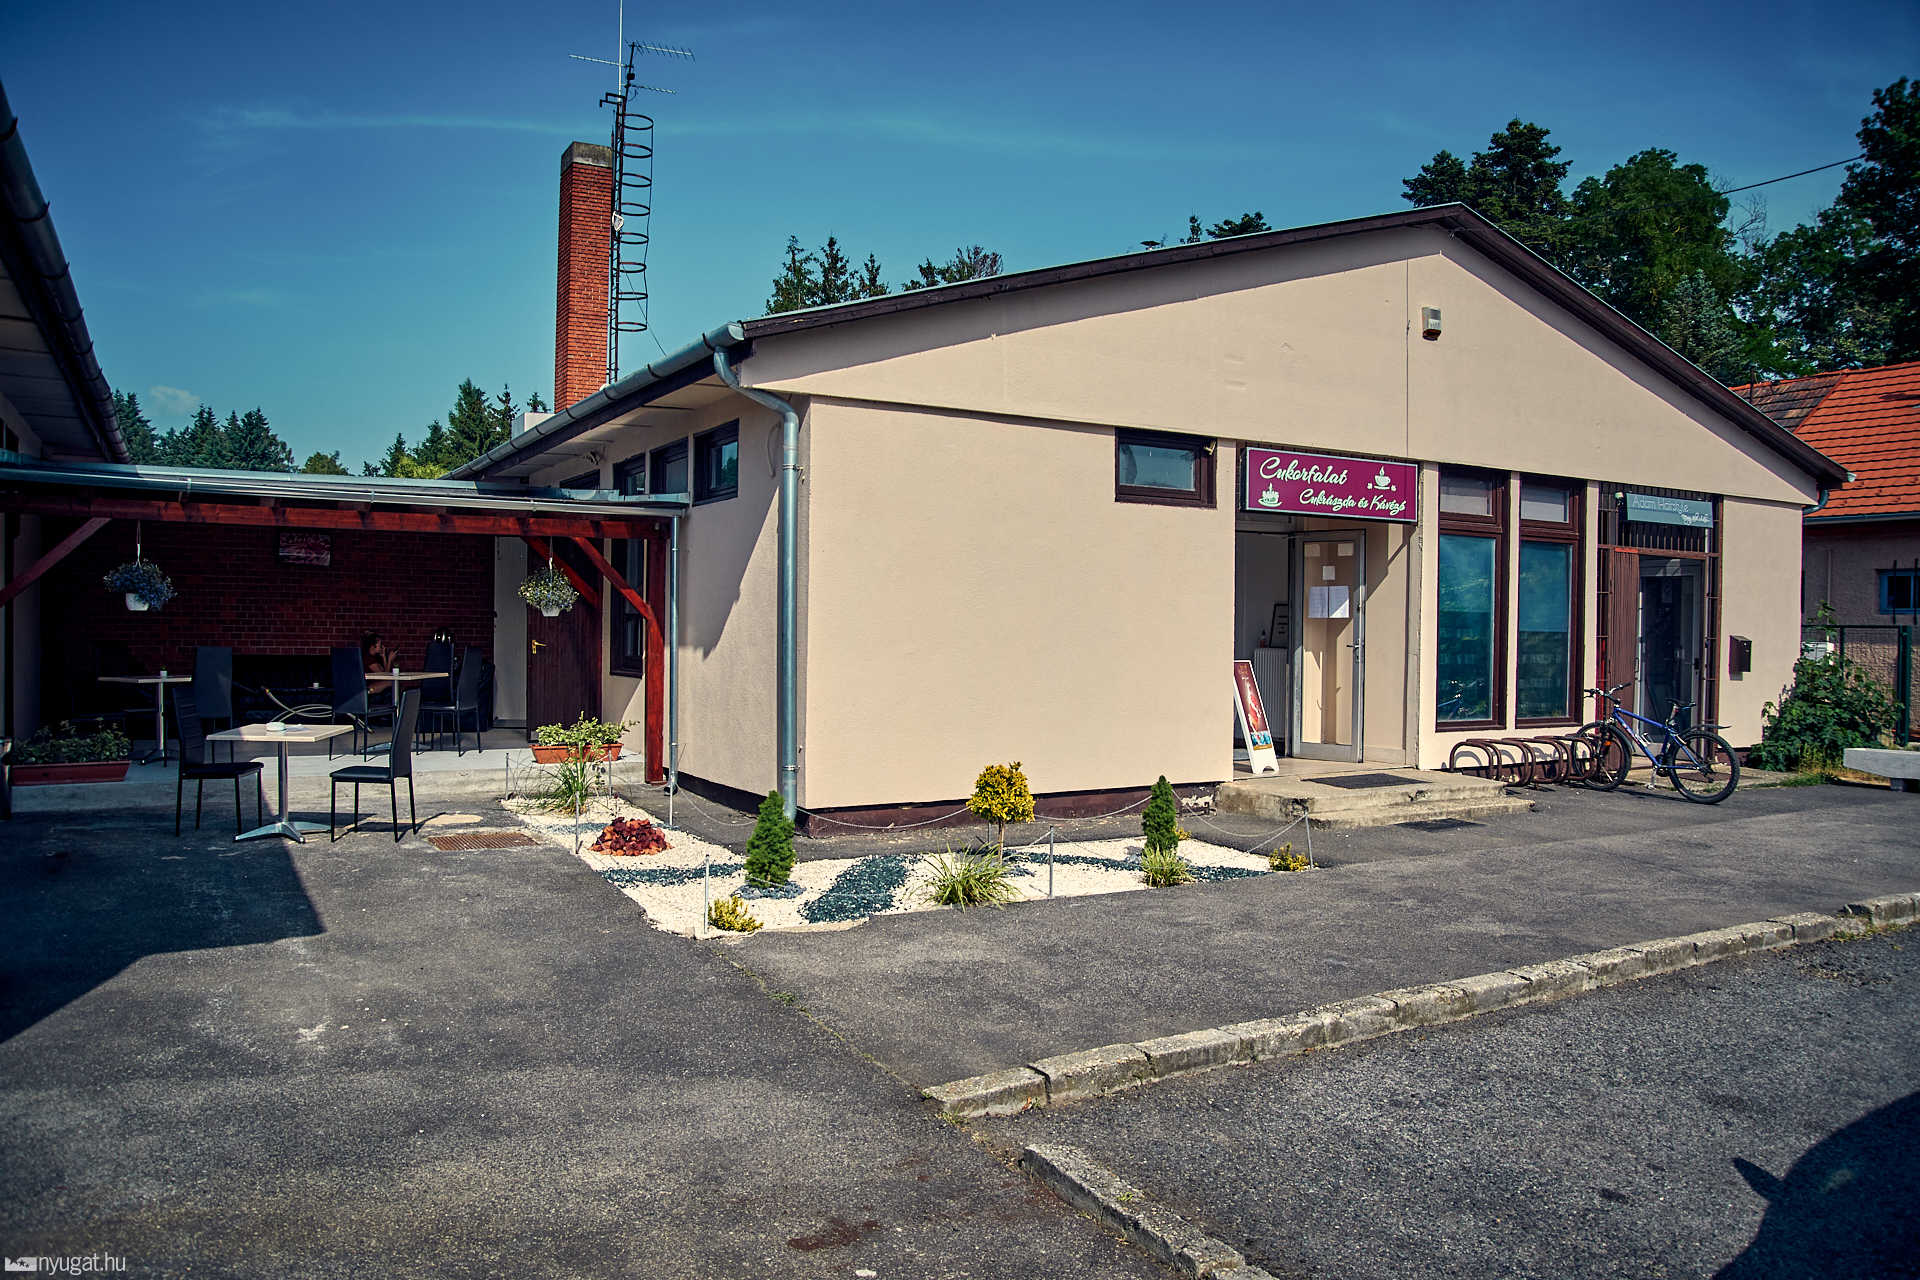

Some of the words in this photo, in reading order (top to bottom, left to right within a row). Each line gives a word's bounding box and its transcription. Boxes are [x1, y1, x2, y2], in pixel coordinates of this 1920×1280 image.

[1259, 456, 1349, 485] Cukorfalat
[1299, 488, 1356, 511] Cukrászda
[1358, 495, 1368, 508] és
